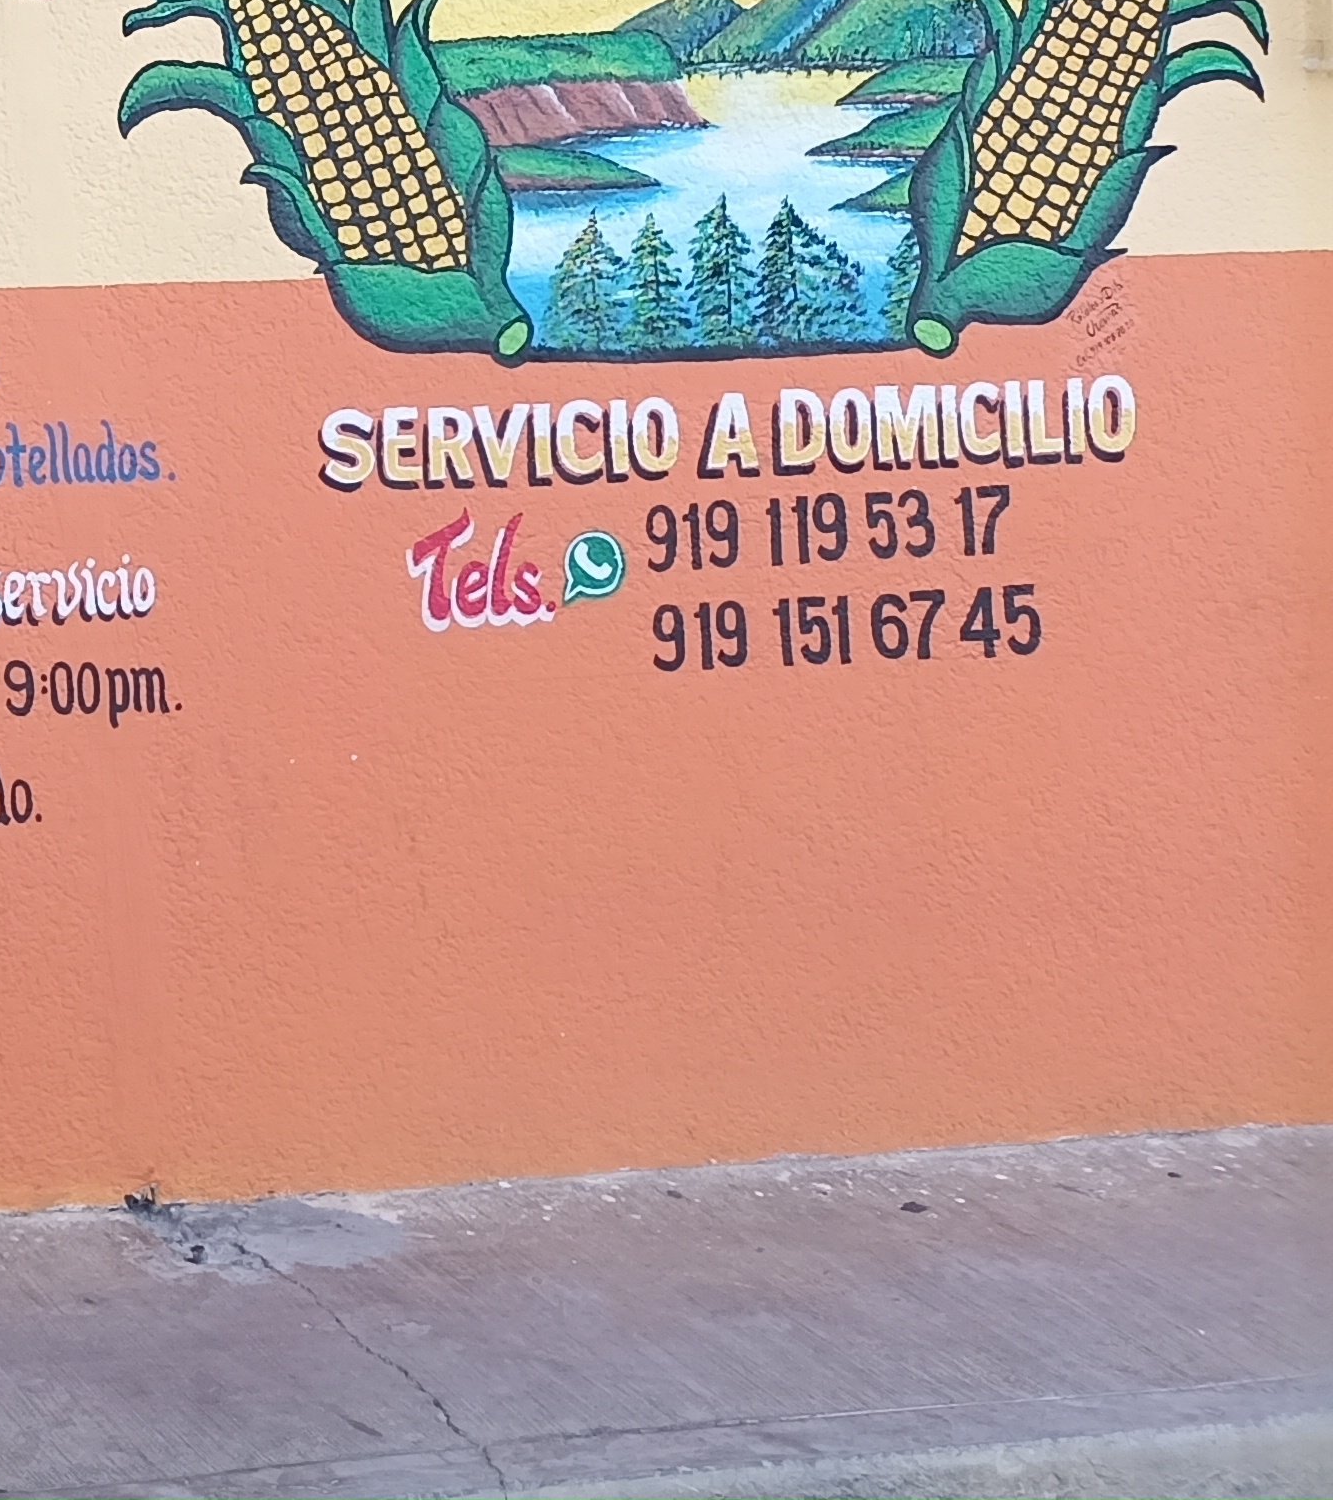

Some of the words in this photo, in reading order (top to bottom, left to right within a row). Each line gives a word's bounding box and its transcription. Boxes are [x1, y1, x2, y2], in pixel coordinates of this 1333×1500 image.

[318, 398, 679, 493] SERVICIO
[698, 393, 761, 478] A
[772, 374, 1137, 477] DOMICILIO
[406, 506, 557, 632] Tels.
[644, 499, 740, 573] 919
[767, 492, 848, 567] 119
[868, 488, 936, 560] 53
[954, 484, 1012, 557] 17
[651, 602, 749, 673] 919
[773, 595, 853, 667] 151
[870, 589, 947, 662] 67
[959, 584, 1044, 657] 45
